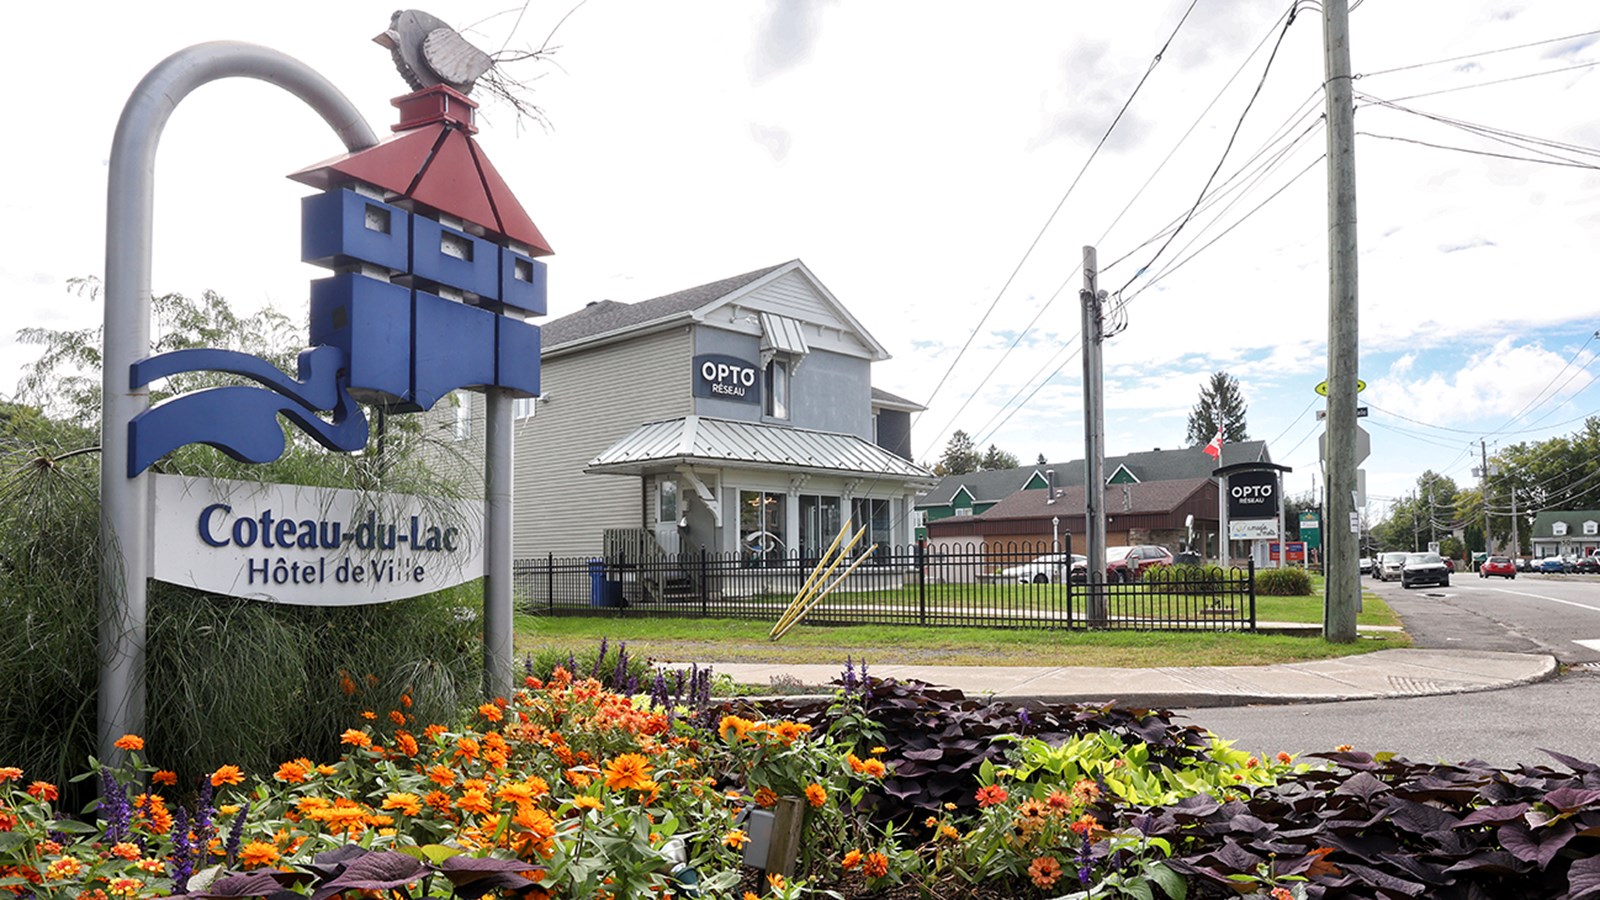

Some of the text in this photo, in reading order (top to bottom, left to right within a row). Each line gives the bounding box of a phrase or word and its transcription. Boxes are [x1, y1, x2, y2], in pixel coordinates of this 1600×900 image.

[702, 361, 754, 387] OPTO
[712, 383, 745, 397] RÉSEAU
[1231, 485, 1272, 498] OPTO
[198, 503, 459, 553] Coteau-du-Lac
[249, 557, 425, 585] Hôtel de Ville
